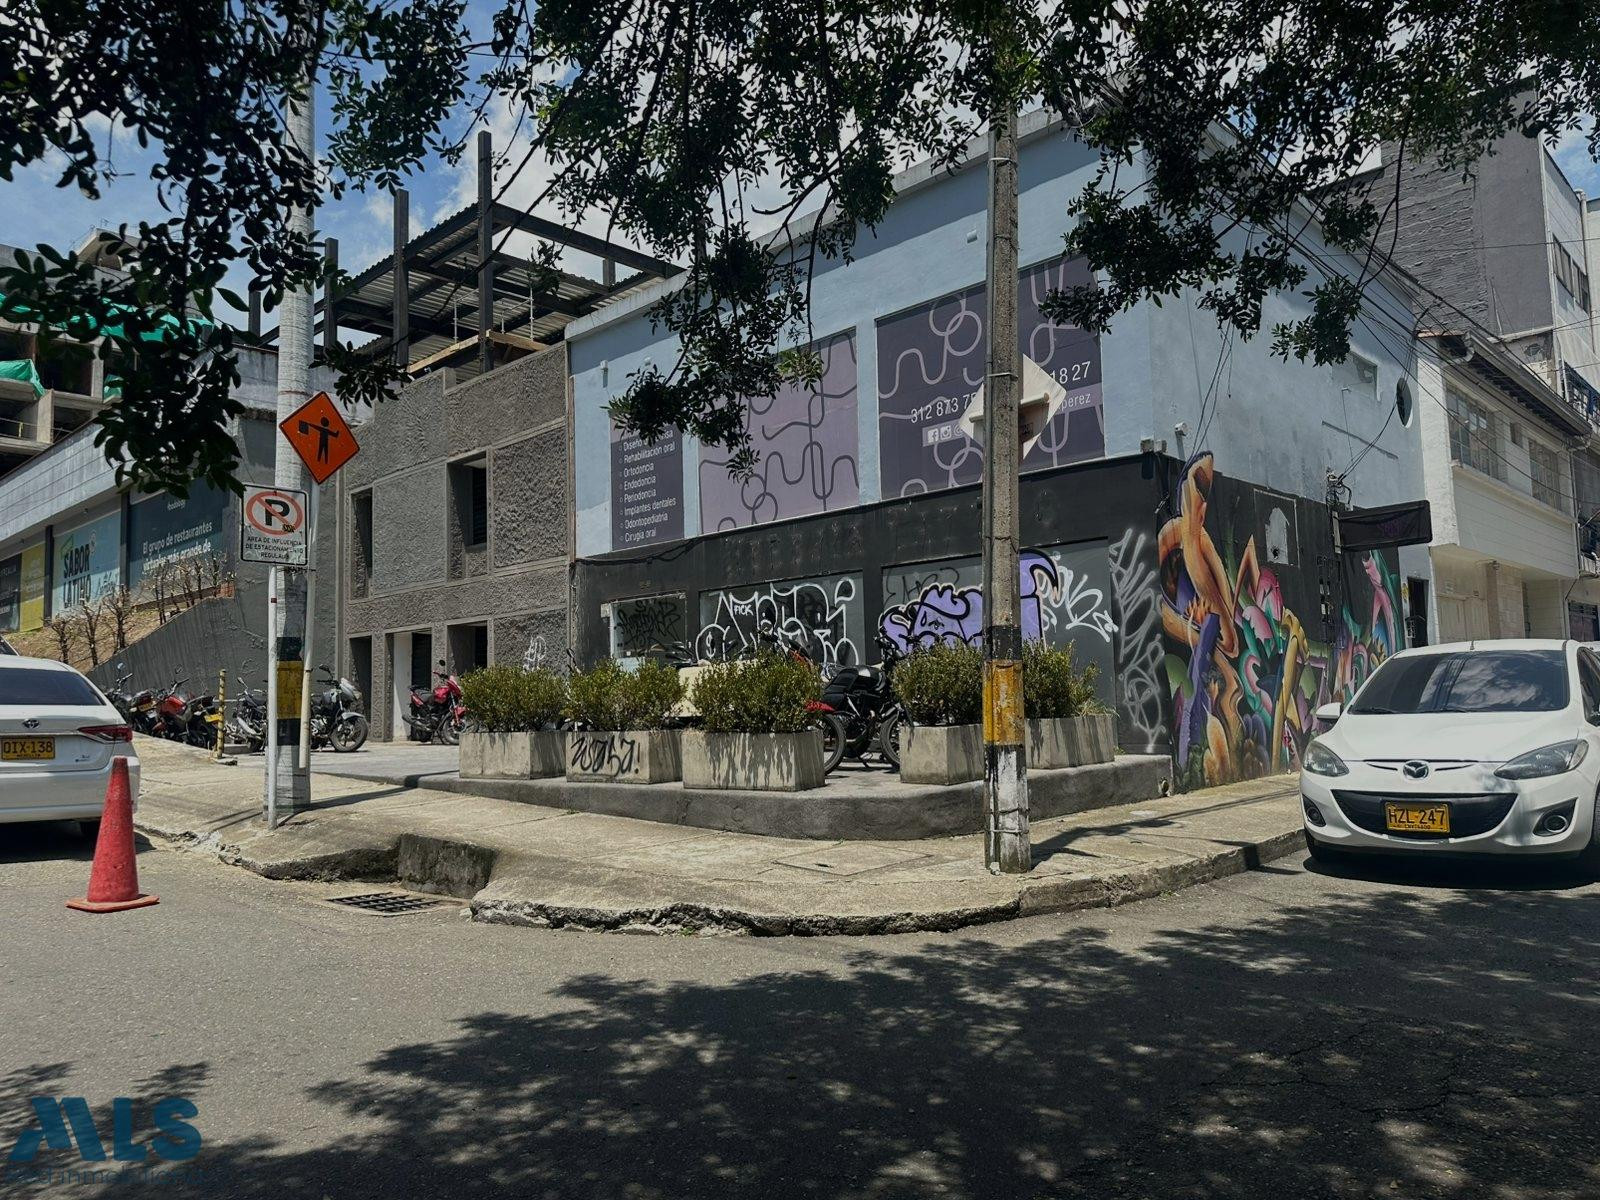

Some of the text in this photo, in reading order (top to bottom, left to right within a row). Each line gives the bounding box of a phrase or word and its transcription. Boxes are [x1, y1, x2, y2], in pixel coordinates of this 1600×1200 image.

[910, 403, 932, 424] 312
[936, 397, 959, 417] 873
[1071, 360, 1091, 381] 27
[1059, 393, 1091, 412] perez
[663, 441, 676, 453] oral
[623, 462, 655, 478] Ortodoncia
[623, 475, 657, 491] Endodoncia
[623, 488, 657, 503] Periodoncia
[624, 497, 677, 517] Implantes dentales
[142, 521, 213, 556] El grupo de restaurantes
[645, 526, 657, 538] oral
[203, 539, 211, 553] de
[272, 538, 302, 546] INFLUENCIA
[63, 543, 90, 579] SABOR
